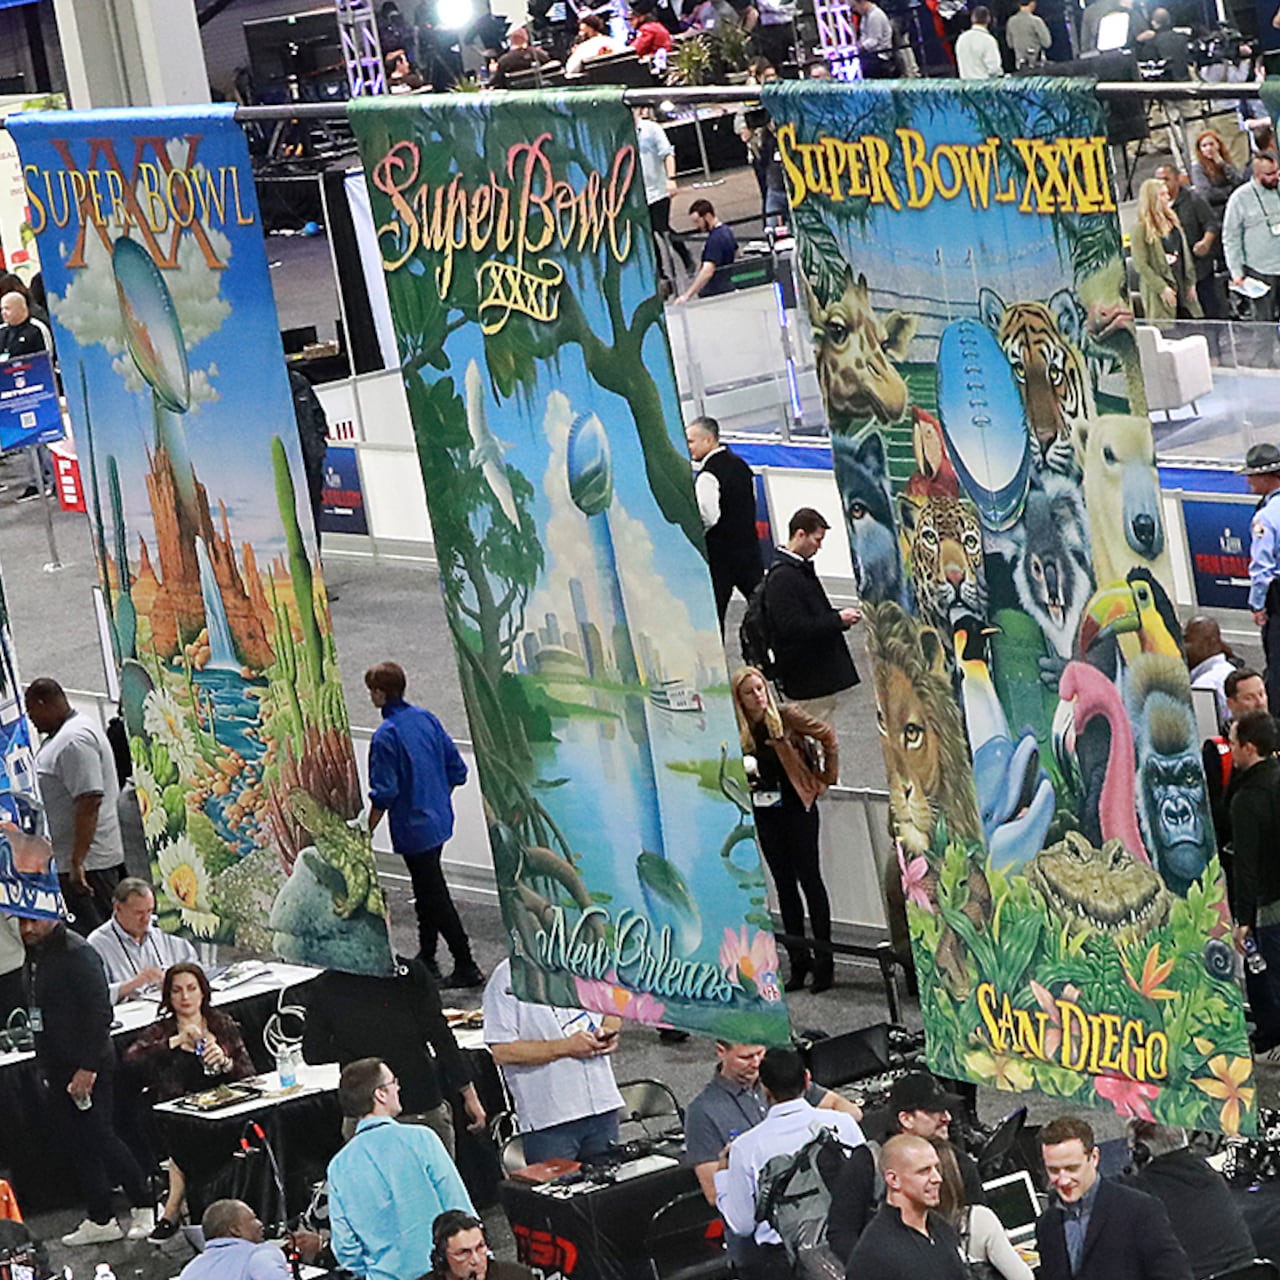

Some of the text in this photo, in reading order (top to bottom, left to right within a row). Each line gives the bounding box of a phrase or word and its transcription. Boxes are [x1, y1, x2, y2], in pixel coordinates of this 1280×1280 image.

[23, 162, 255, 234] SUPER BOWL
[372, 132, 636, 301] Super Bowl
[776, 121, 1117, 214] SUPER BOWL XXXII
[535, 903, 745, 1002] New Orleans
[976, 982, 1169, 1082] SAN DIEGO
